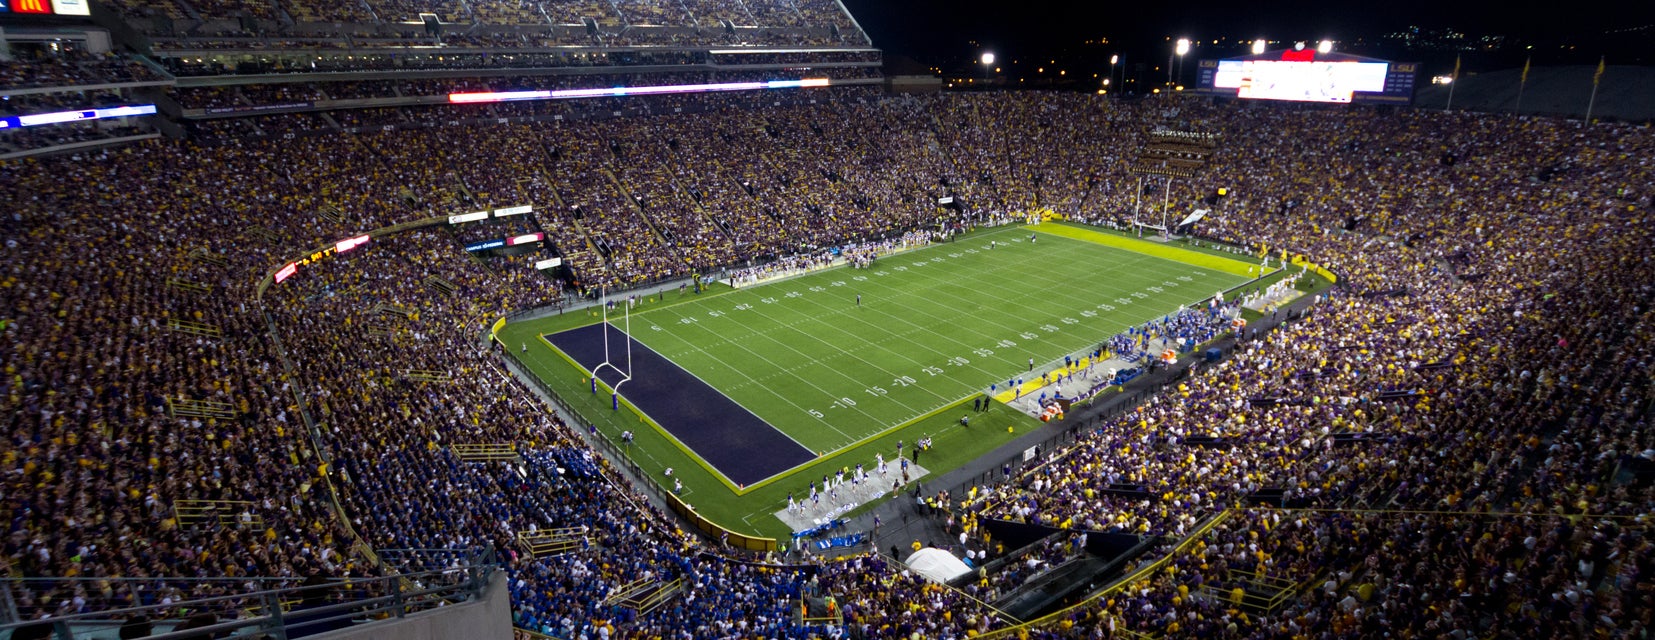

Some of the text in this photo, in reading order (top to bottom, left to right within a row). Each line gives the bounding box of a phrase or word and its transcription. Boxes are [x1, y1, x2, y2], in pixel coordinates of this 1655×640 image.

[1390, 64, 1415, 73] LSU
[1061, 317, 1079, 325] 45
[1040, 324, 1059, 332] 50
[1019, 331, 1039, 340] 45
[997, 339, 1017, 348] 40
[973, 347, 994, 357] 35
[948, 356, 970, 367] 30
[922, 365, 944, 376] 25
[894, 375, 917, 387] 20
[865, 385, 888, 397] 15
[834, 397, 857, 409] 10
[808, 408, 824, 419] 5
